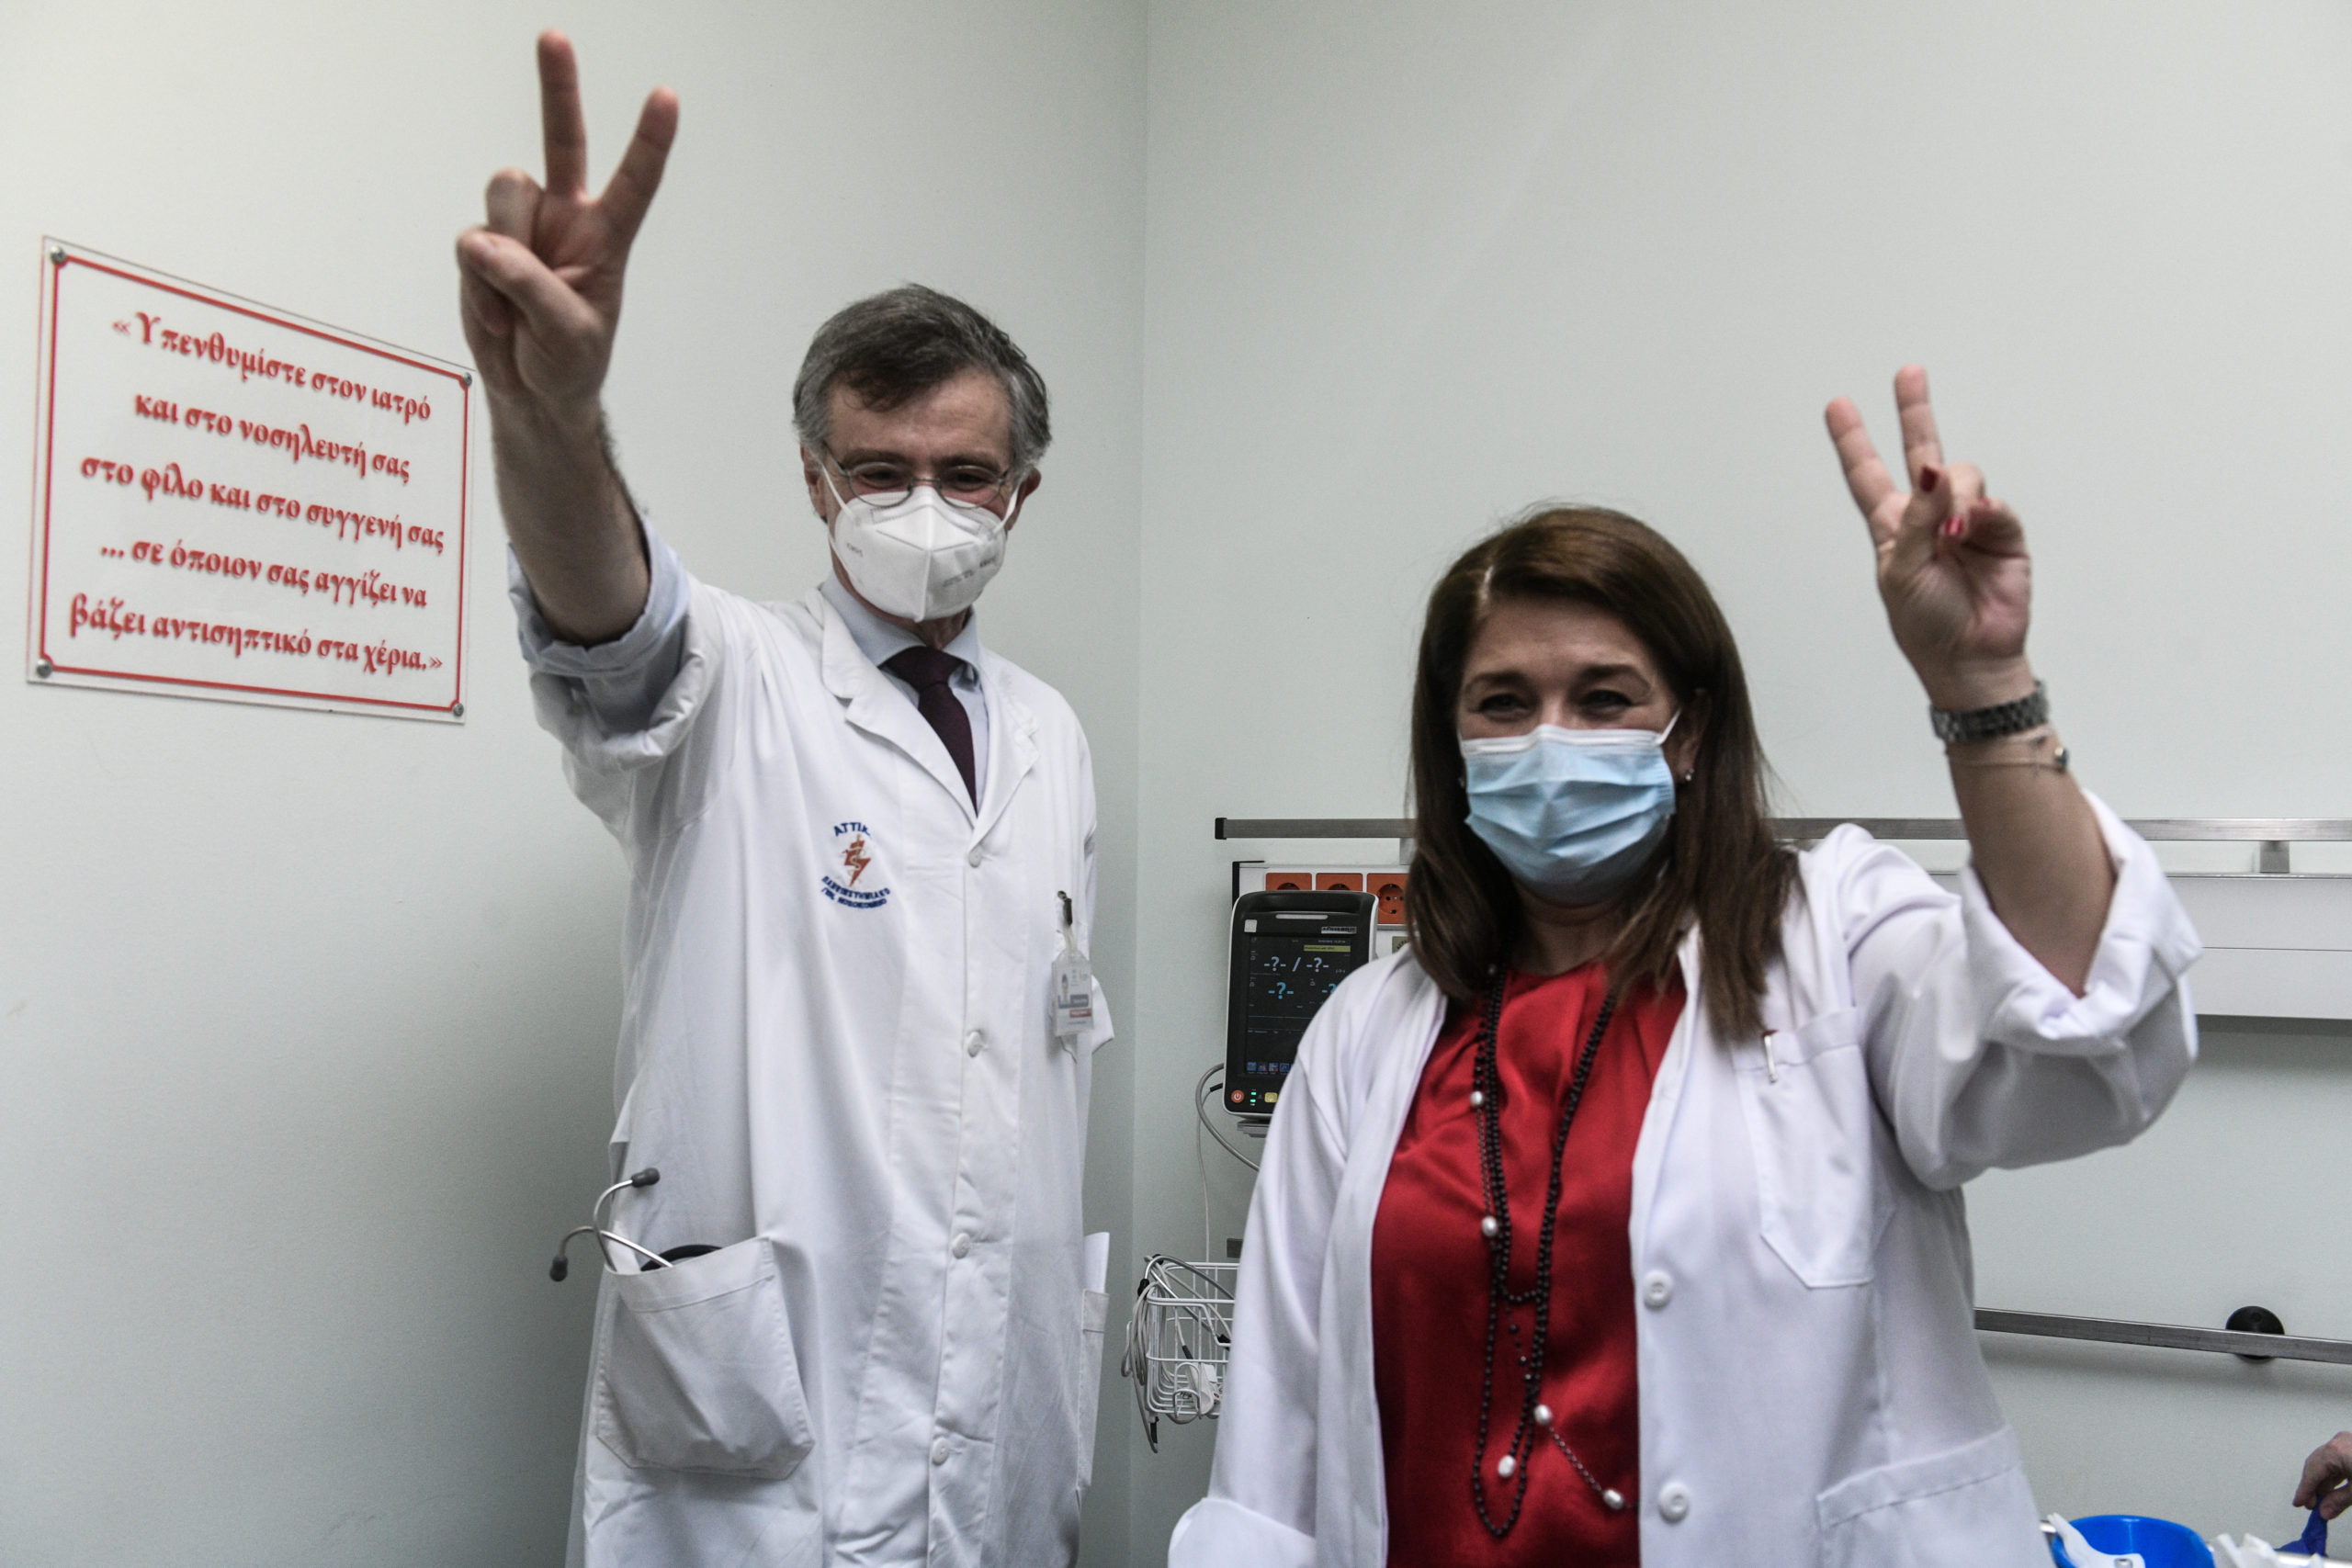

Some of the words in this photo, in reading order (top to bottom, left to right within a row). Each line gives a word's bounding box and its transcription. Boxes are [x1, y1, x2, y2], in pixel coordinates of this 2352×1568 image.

[113, 310, 307, 387] «Υπενθυμίστε
[311, 371, 367, 401] στον
[371, 388, 431, 424] ιατρό
[134, 393, 179, 423] και
[184, 406, 233, 434] στο
[238, 418, 367, 478] νοσηλευτή
[371, 453, 410, 485] σας
[81, 456, 134, 485] στο
[140, 460, 204, 501] φίλο
[209, 482, 252, 510] και
[255, 492, 301, 519] στο
[306, 503, 402, 550] συγγενή
[407, 525, 445, 555] σας
[169, 538, 263, 580] όποιον
[266, 563, 311, 595] σας
[314, 569, 397, 607] αγγίζει
[401, 586, 427, 608] να
[70, 592, 146, 639] βάζει
[152, 616, 312, 658] αντισηπτικό
[316, 638, 359, 662] στα
[833, 821, 872, 838] ΑΤΤΙΚ
